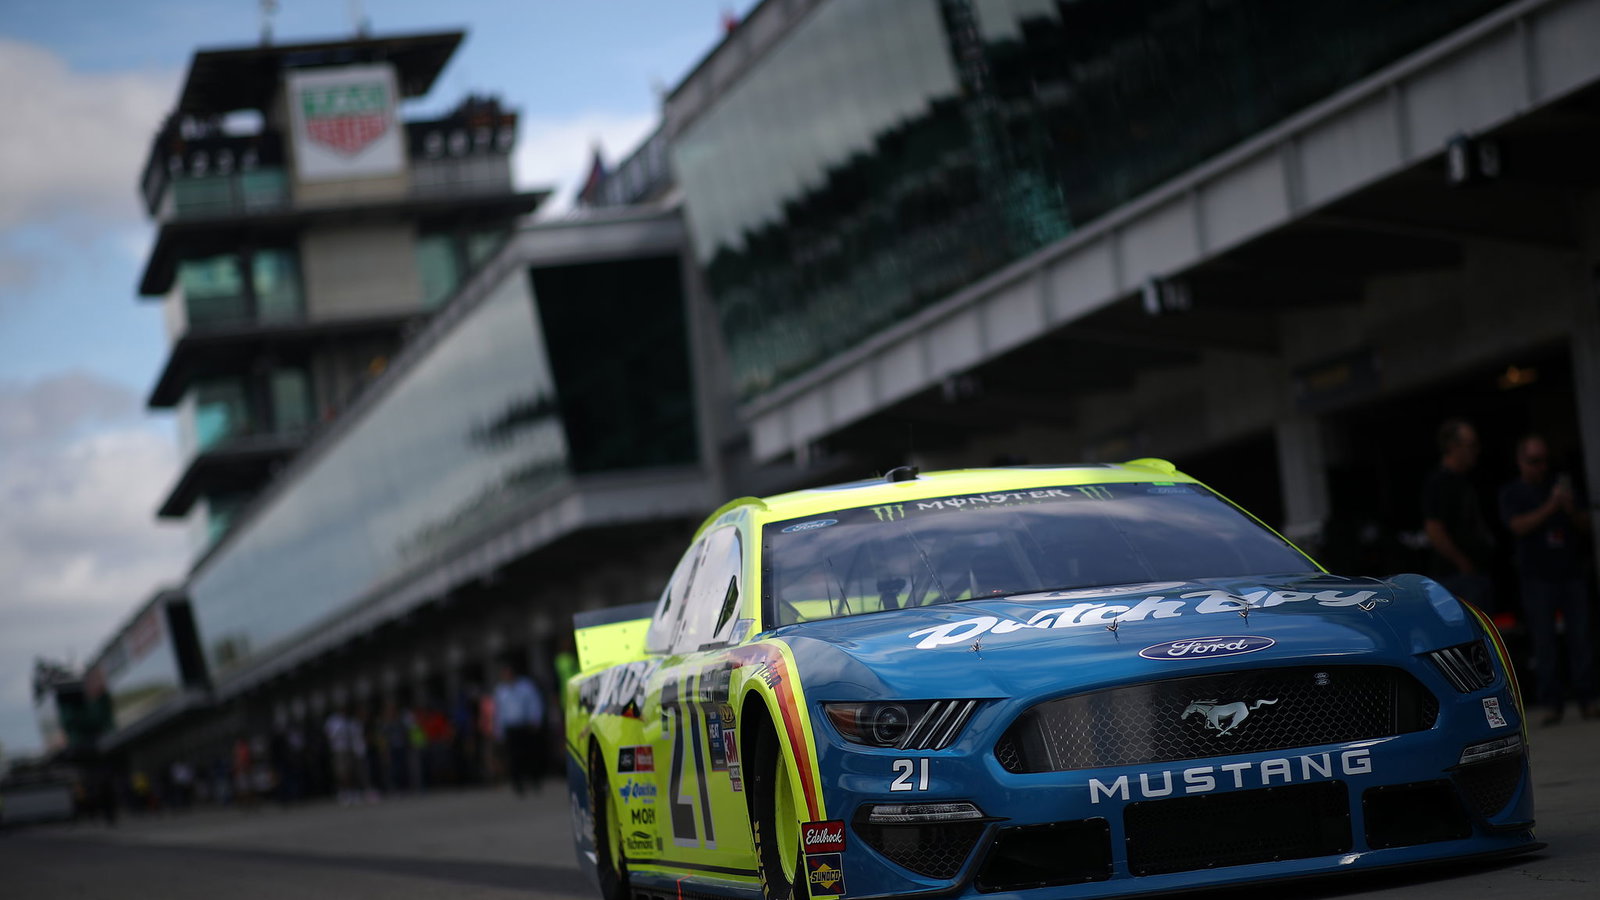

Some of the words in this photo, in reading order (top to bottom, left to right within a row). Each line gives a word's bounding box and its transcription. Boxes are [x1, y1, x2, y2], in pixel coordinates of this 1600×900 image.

[917, 488, 1071, 511] MONSTER
[908, 595, 1187, 649] Dutch
[1179, 589, 1378, 614] Boy
[1167, 637, 1249, 657] Ford
[708, 723, 720, 739] HEAT
[660, 668, 717, 849] 21
[724, 731, 739, 764] 3M
[890, 758, 930, 791] 21
[1088, 748, 1373, 804] MUSTANG
[805, 827, 843, 845] Edelbrock
[811, 870, 841, 882] SUNOCO
